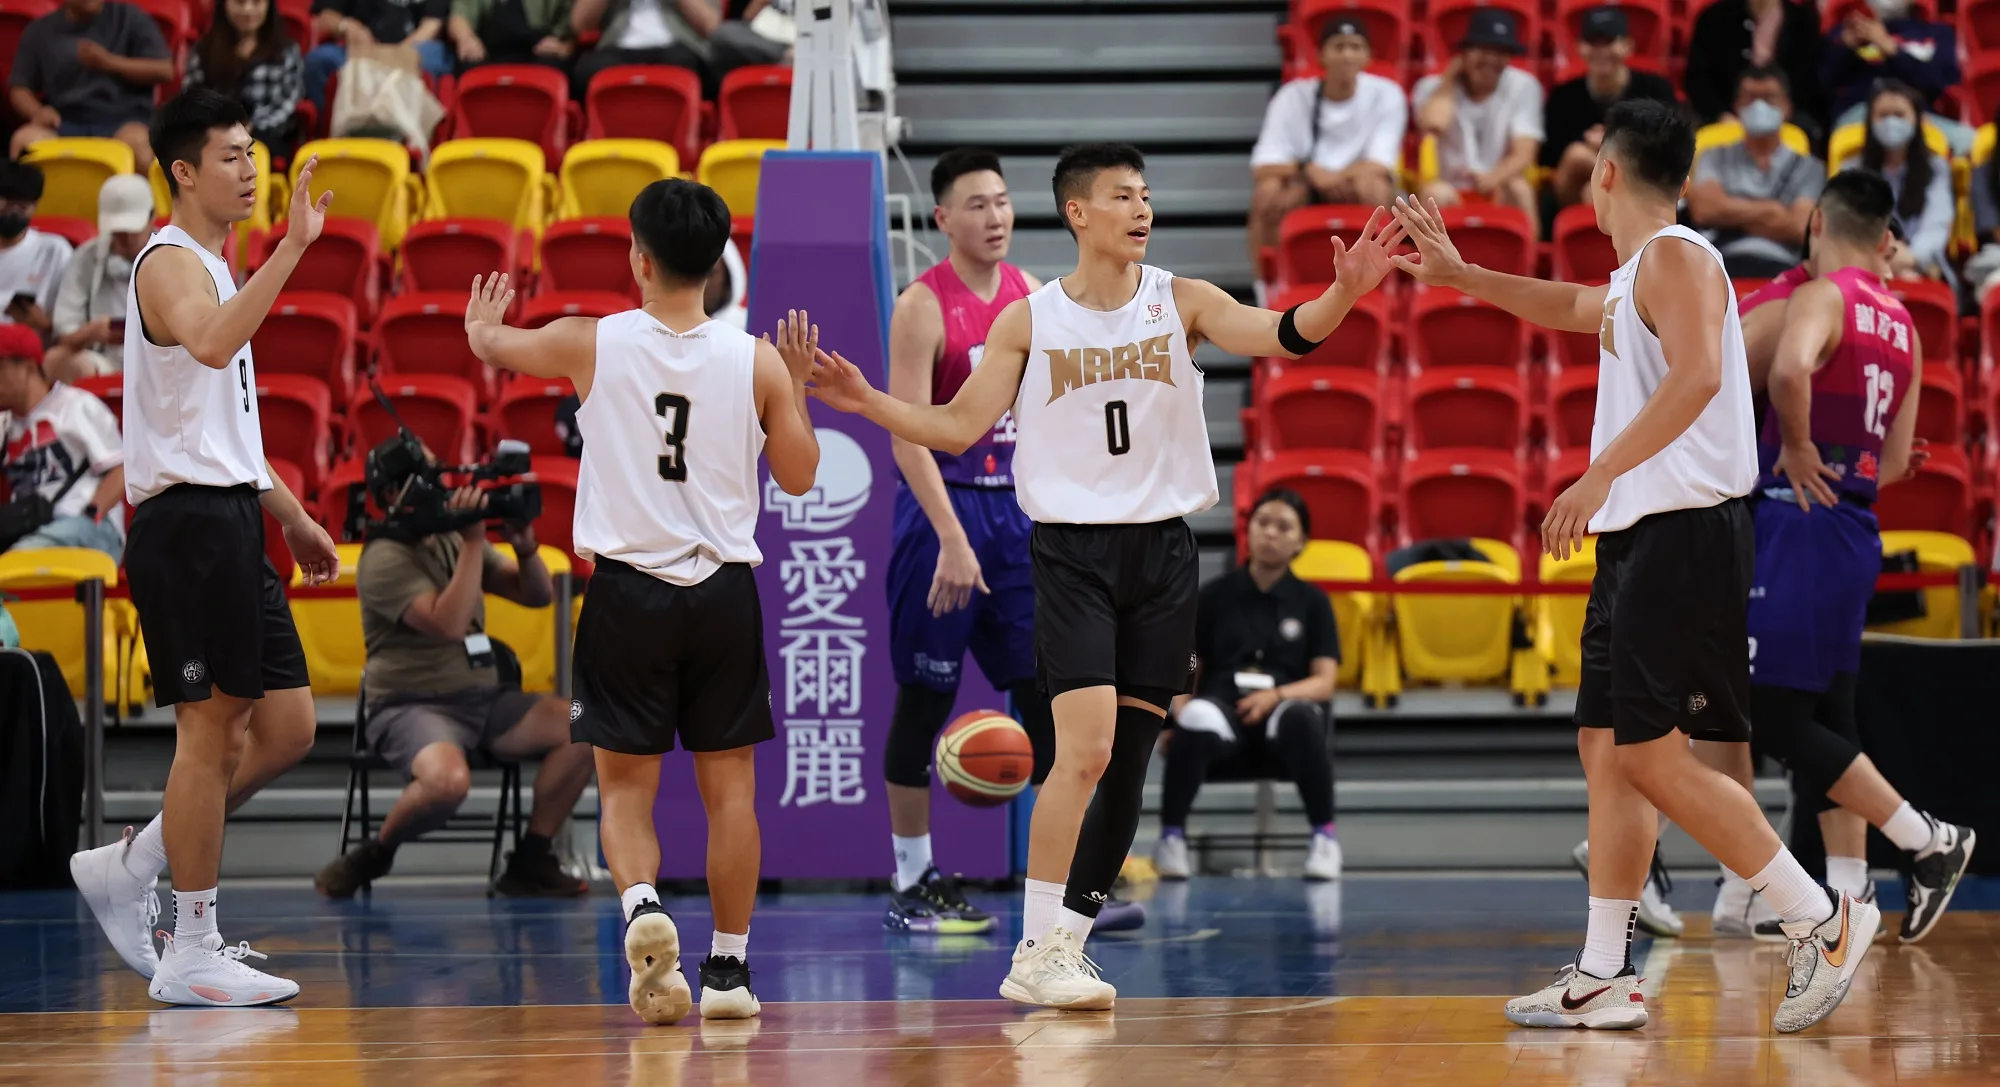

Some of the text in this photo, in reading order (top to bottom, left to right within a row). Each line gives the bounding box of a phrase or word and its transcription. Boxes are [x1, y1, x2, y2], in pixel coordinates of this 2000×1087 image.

[239, 359, 250, 413] 9
[1041, 332, 1178, 407] MARS
[1864, 363, 1895, 441] 12
[654, 391, 692, 484] 3
[1104, 399, 1131, 456] 0
[779, 537, 867, 807] 愛爾麗
